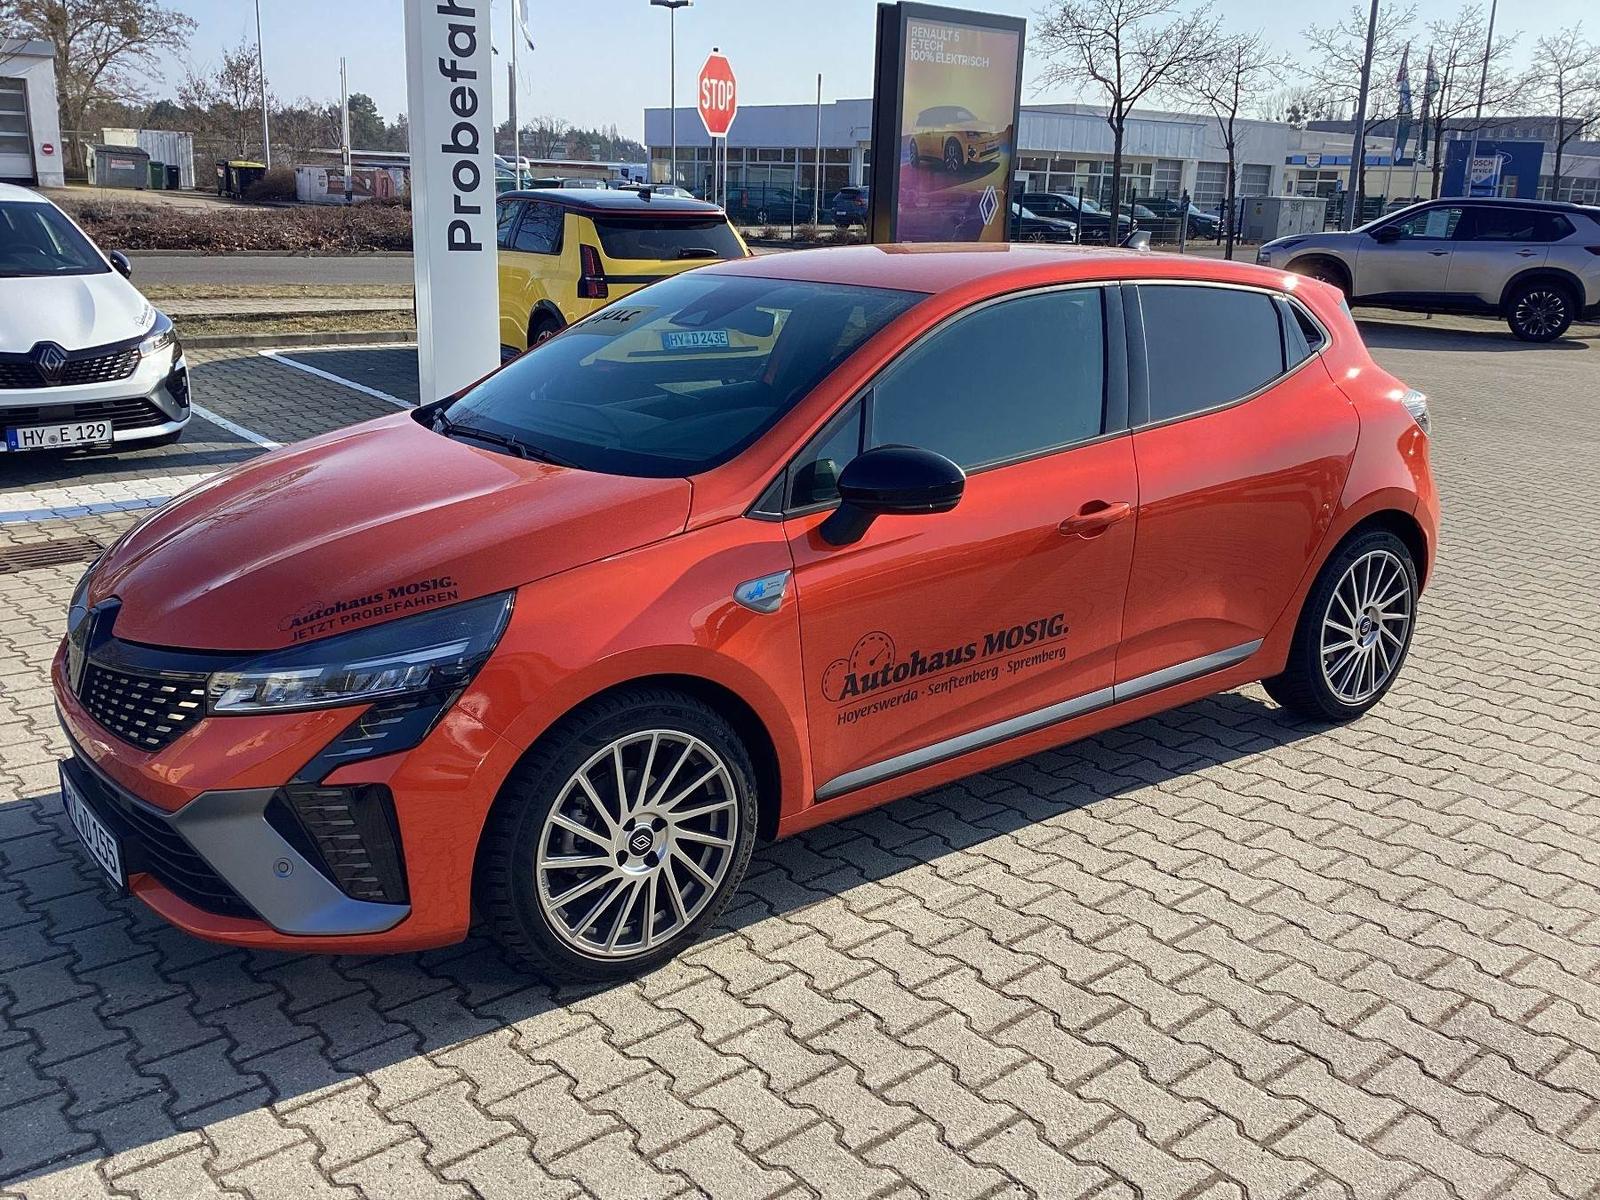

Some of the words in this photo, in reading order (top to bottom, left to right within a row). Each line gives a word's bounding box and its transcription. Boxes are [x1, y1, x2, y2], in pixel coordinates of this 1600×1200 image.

[911, 26, 953, 41] RENAULT
[954, 31, 960, 41] 5
[910, 49, 934, 62] 100%
[935, 52, 990, 68] ELEKTRISCH
[701, 78, 734, 111] STOP
[1472, 159, 1493, 167] OSCH
[670, 332, 685, 346] HY
[692, 332, 699, 345] D
[701, 331, 726, 344] 243E
[23, 429, 45, 446] HY
[60, 427, 71, 442] E
[76, 423, 106, 440] 129
[290, 593, 384, 628] Autohaus
[387, 576, 458, 600] MOSIG.
[291, 618, 337, 642] JETZT
[340, 590, 458, 625] PROBEFAHREN
[838, 640, 977, 701] Autohaus
[982, 613, 1069, 658] MOSIG.
[837, 688, 918, 725] Hoyerswerda
[927, 667, 999, 697] Senftenberg
[1007, 646, 1066, 674] Spremberg
